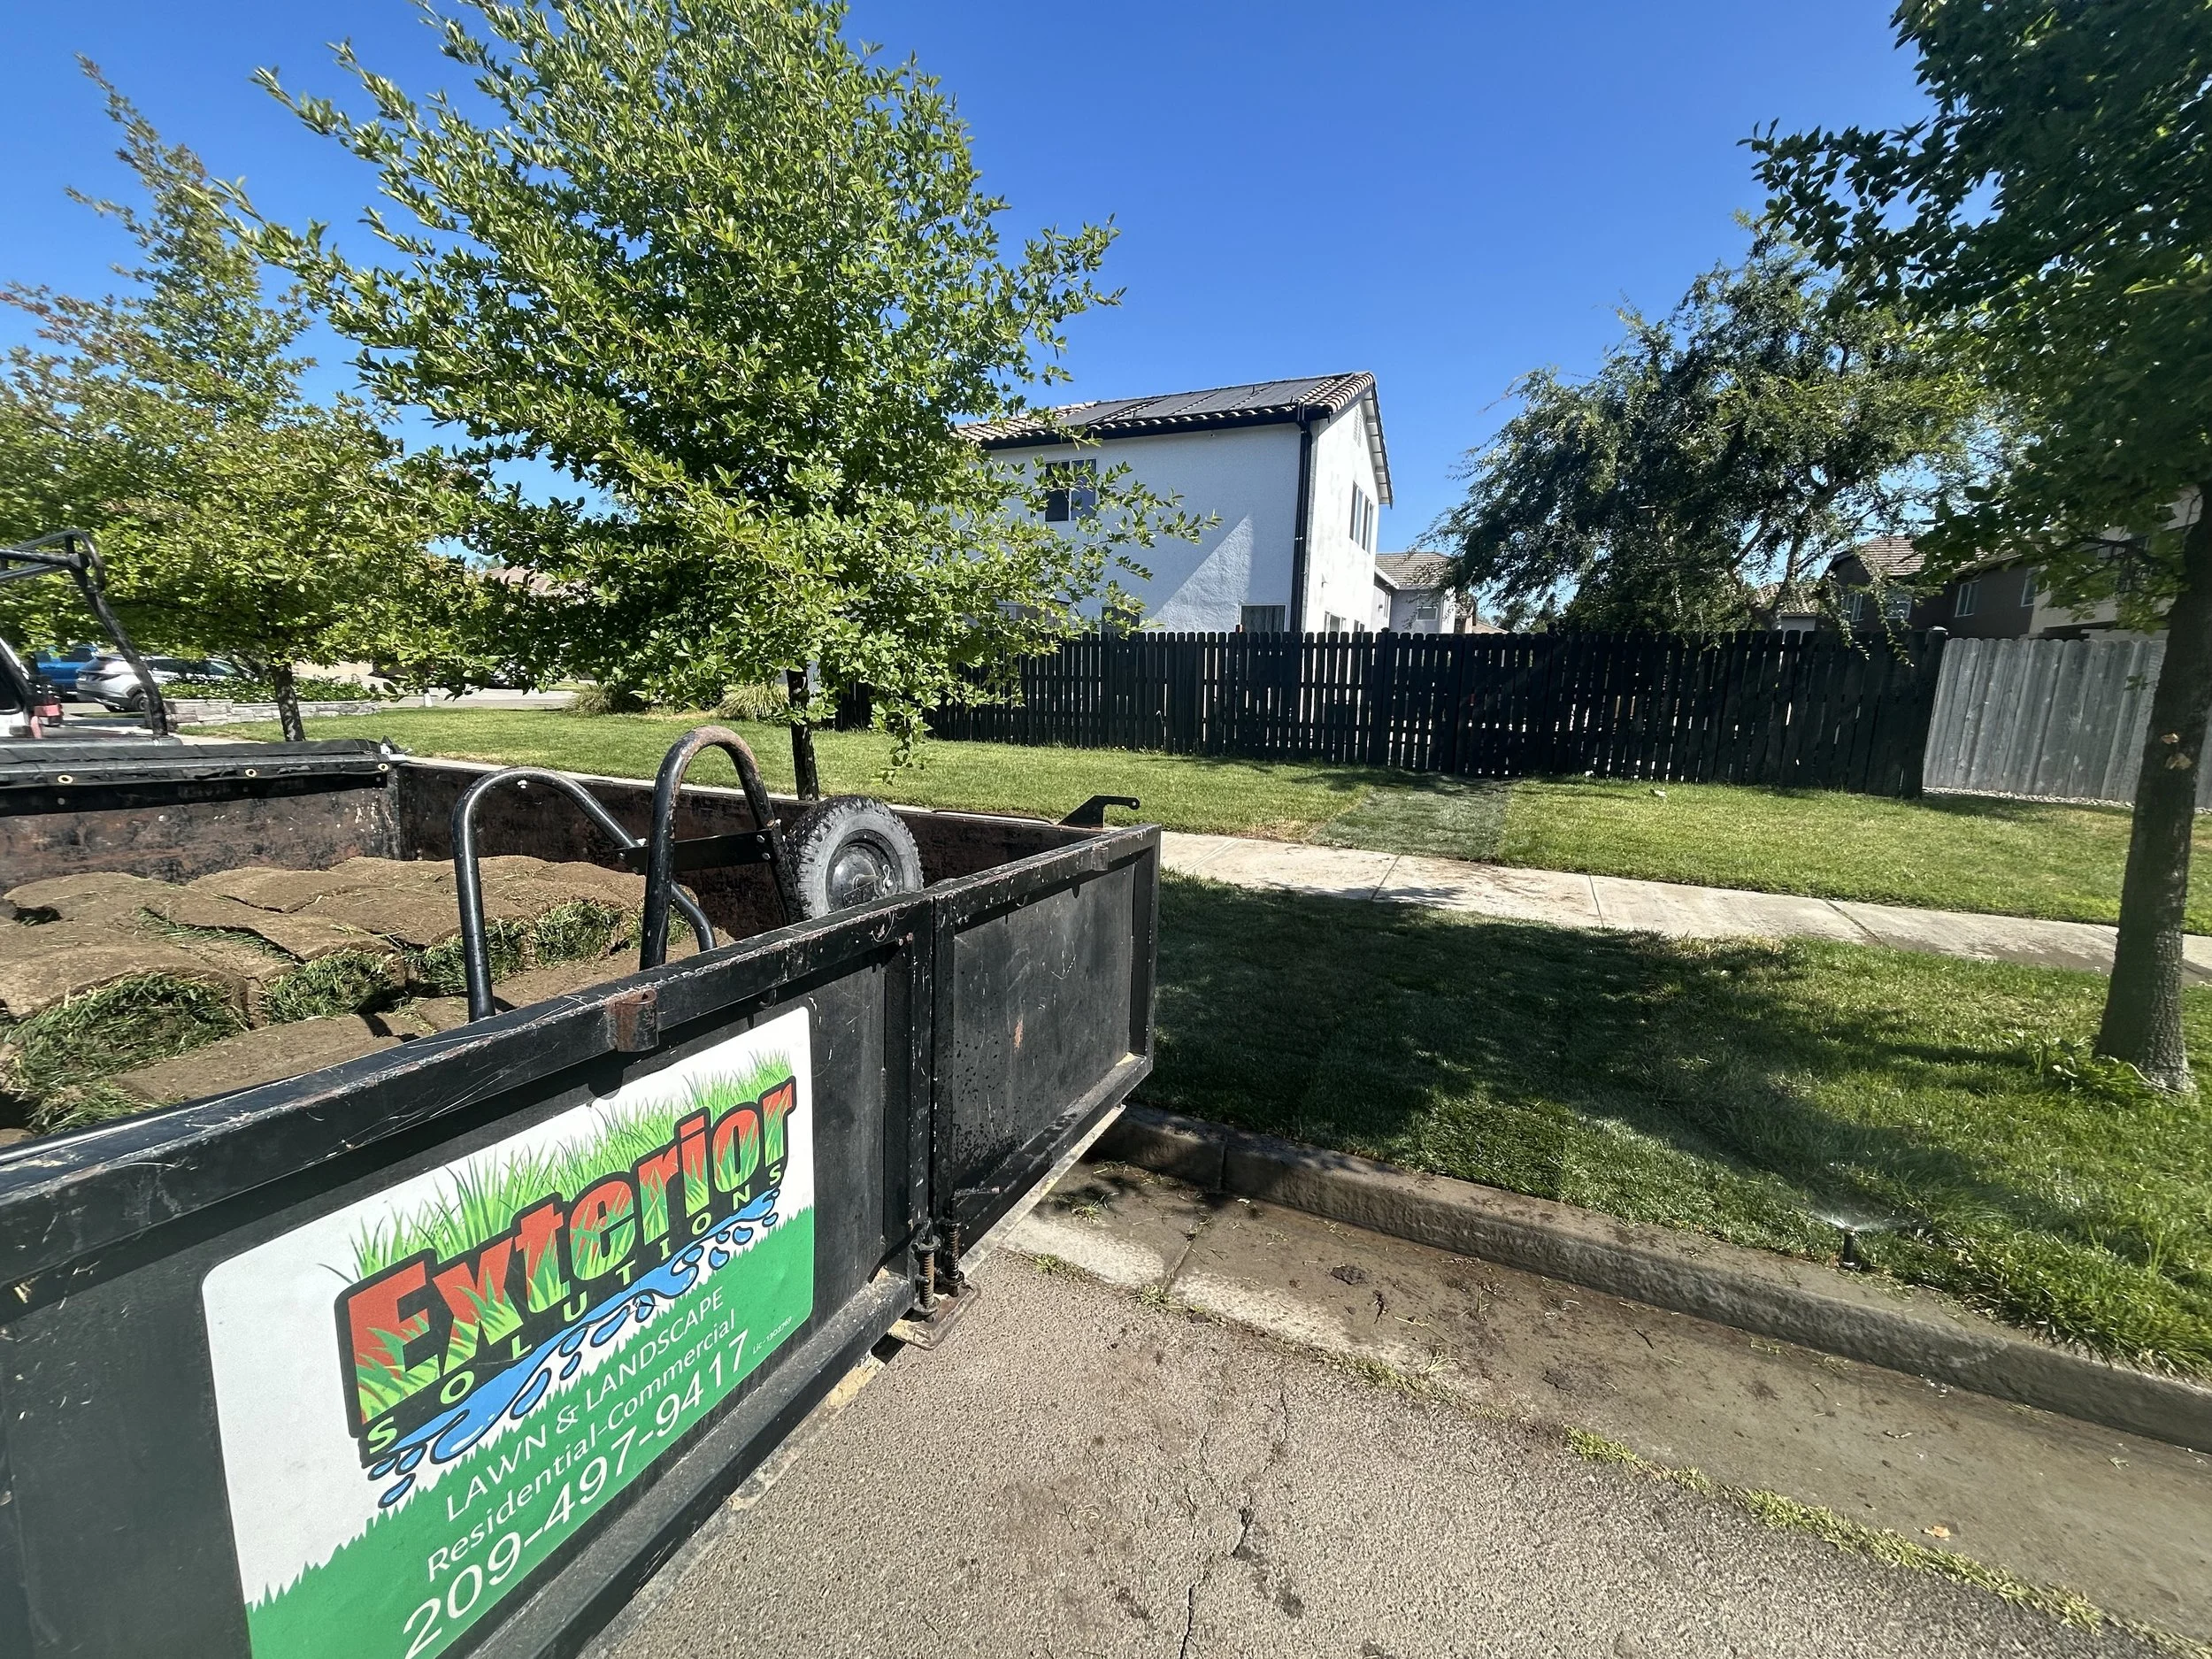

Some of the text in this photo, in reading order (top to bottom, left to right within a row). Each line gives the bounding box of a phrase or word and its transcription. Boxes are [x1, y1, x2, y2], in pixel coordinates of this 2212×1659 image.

[348, 1081, 795, 1425] Exterior
[367, 1164, 781, 1455] SOLUTIONS
[403, 1328, 749, 1659] 209-497-9417
[427, 1308, 735, 1583] Residential-Commercial
[446, 1286, 724, 1523] LAWN & LANDSCAPE
